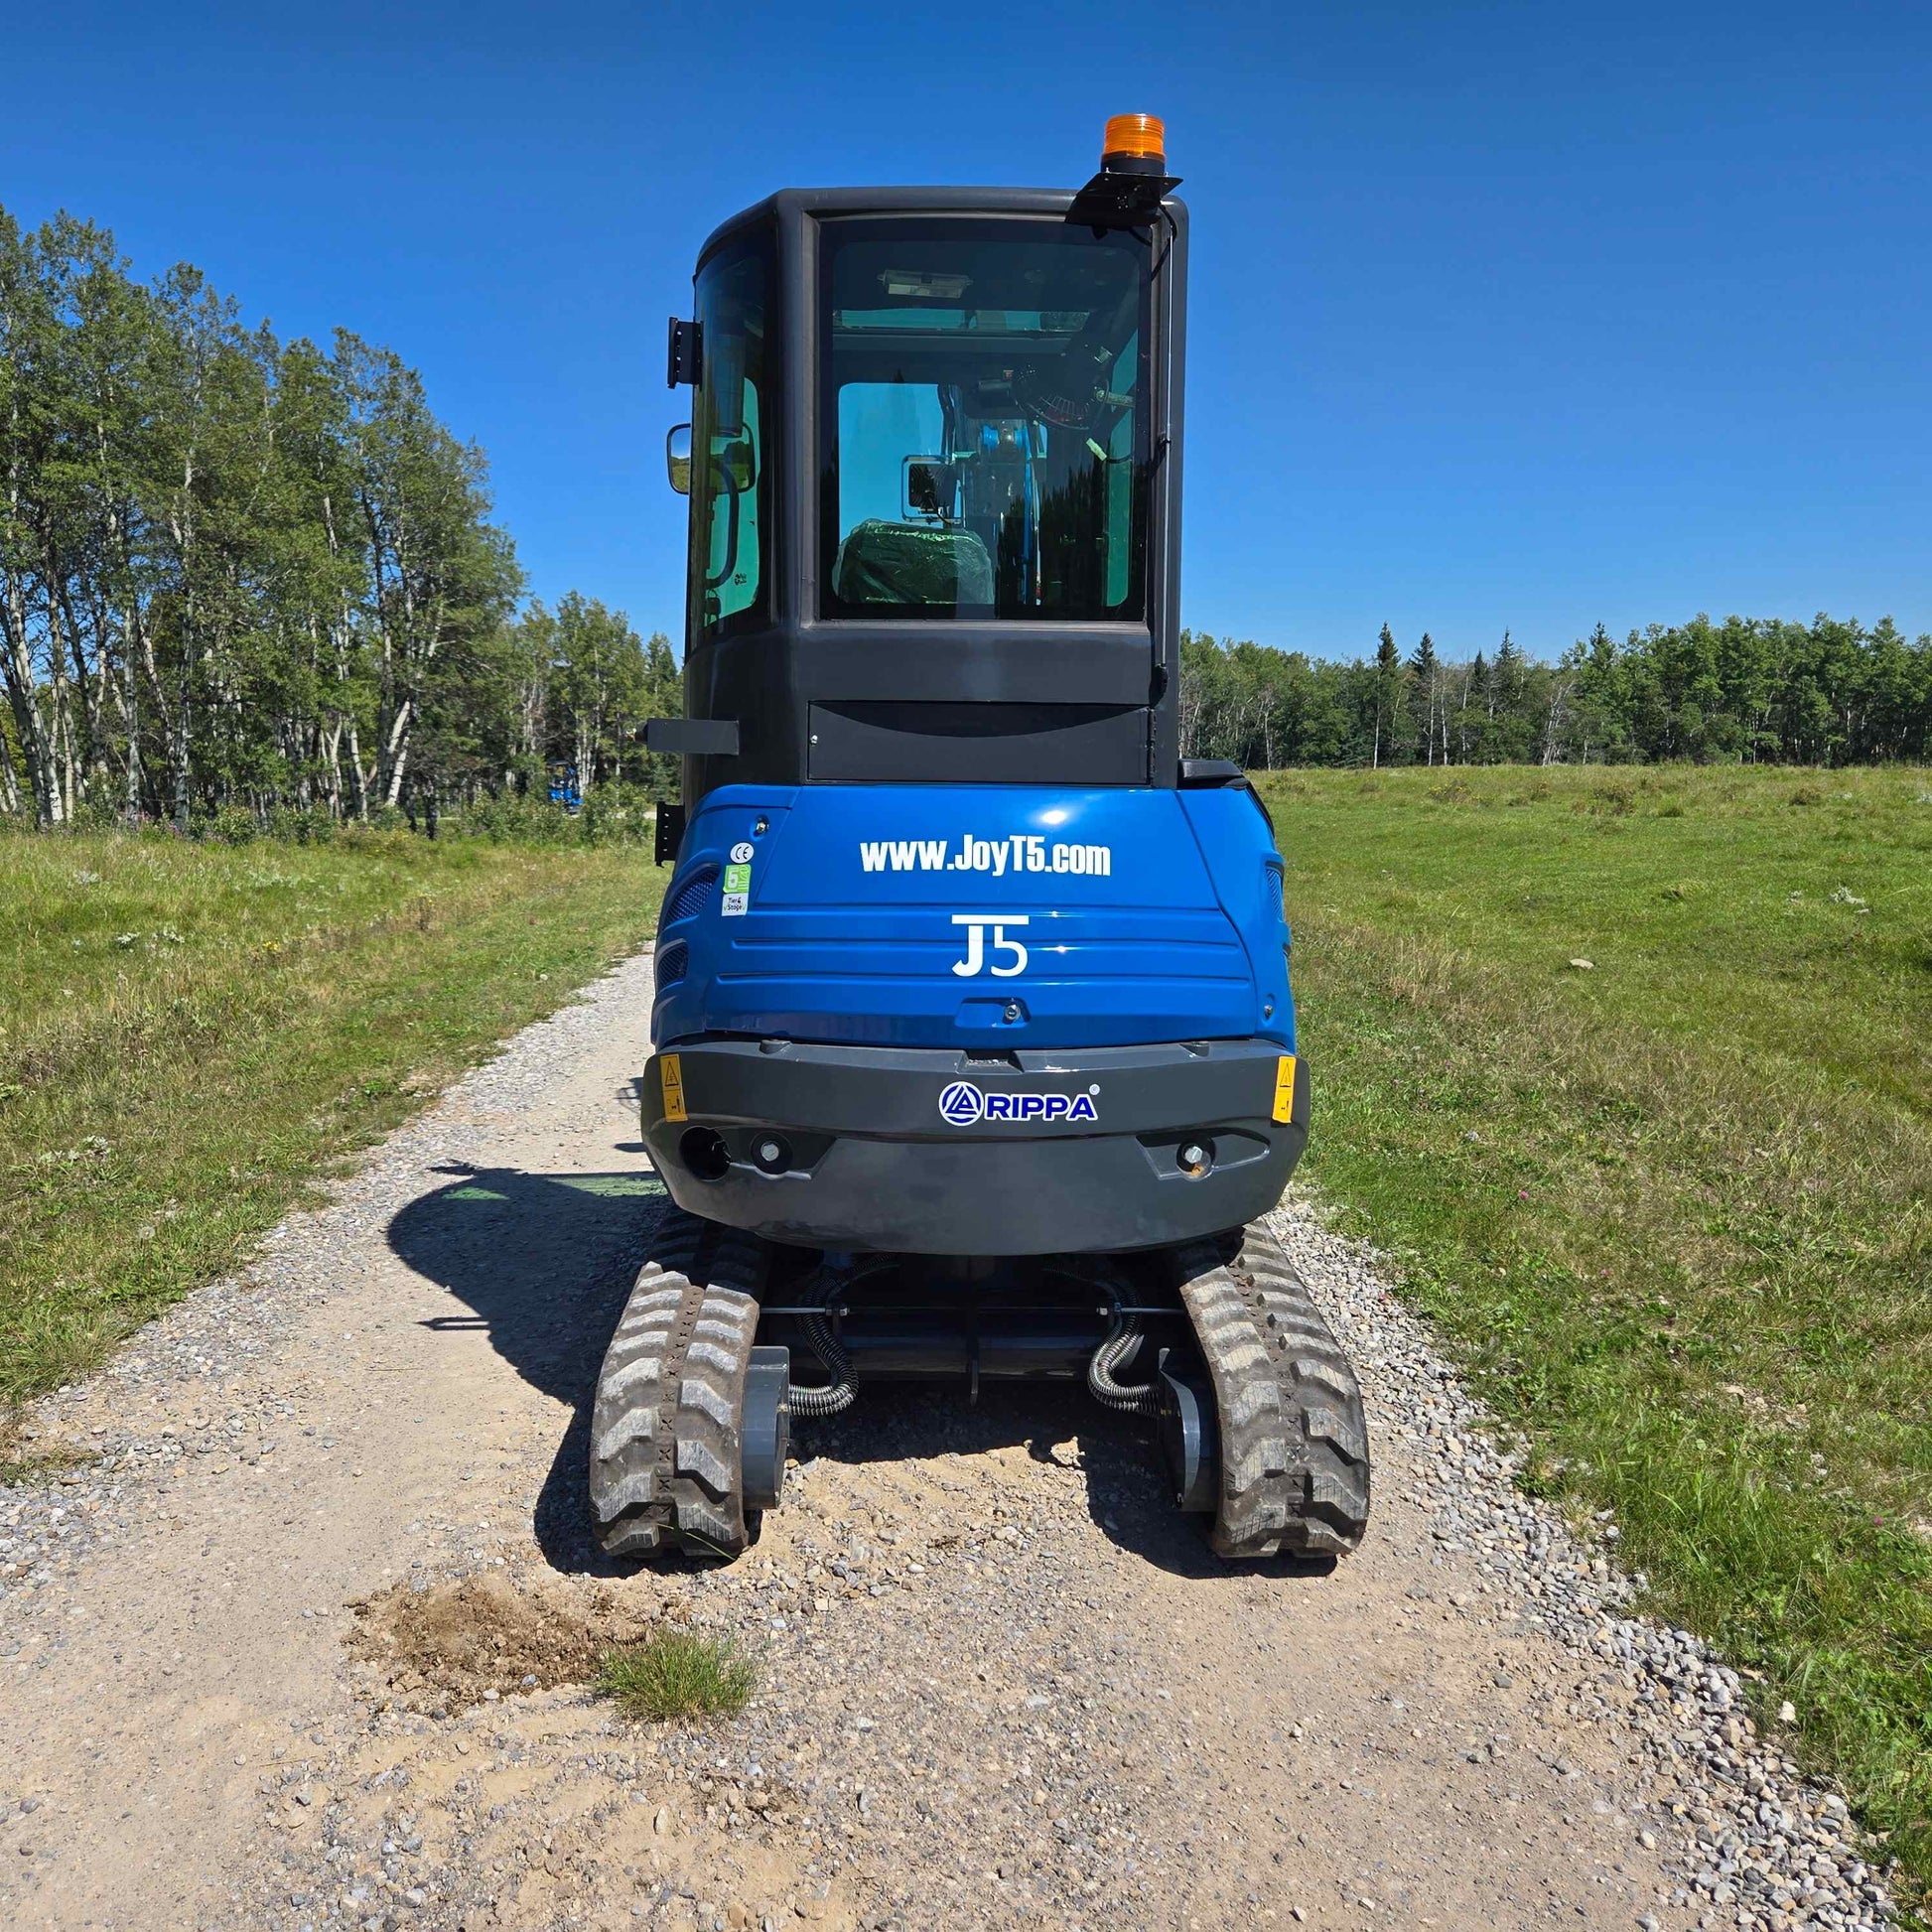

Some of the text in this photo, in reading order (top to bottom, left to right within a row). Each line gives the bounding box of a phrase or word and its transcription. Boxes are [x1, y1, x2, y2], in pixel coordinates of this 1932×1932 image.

[860, 834, 1111, 877] www.JoyT5.com
[951, 915, 1030, 977] J5
[986, 1095, 1096, 1119] RIPPA
